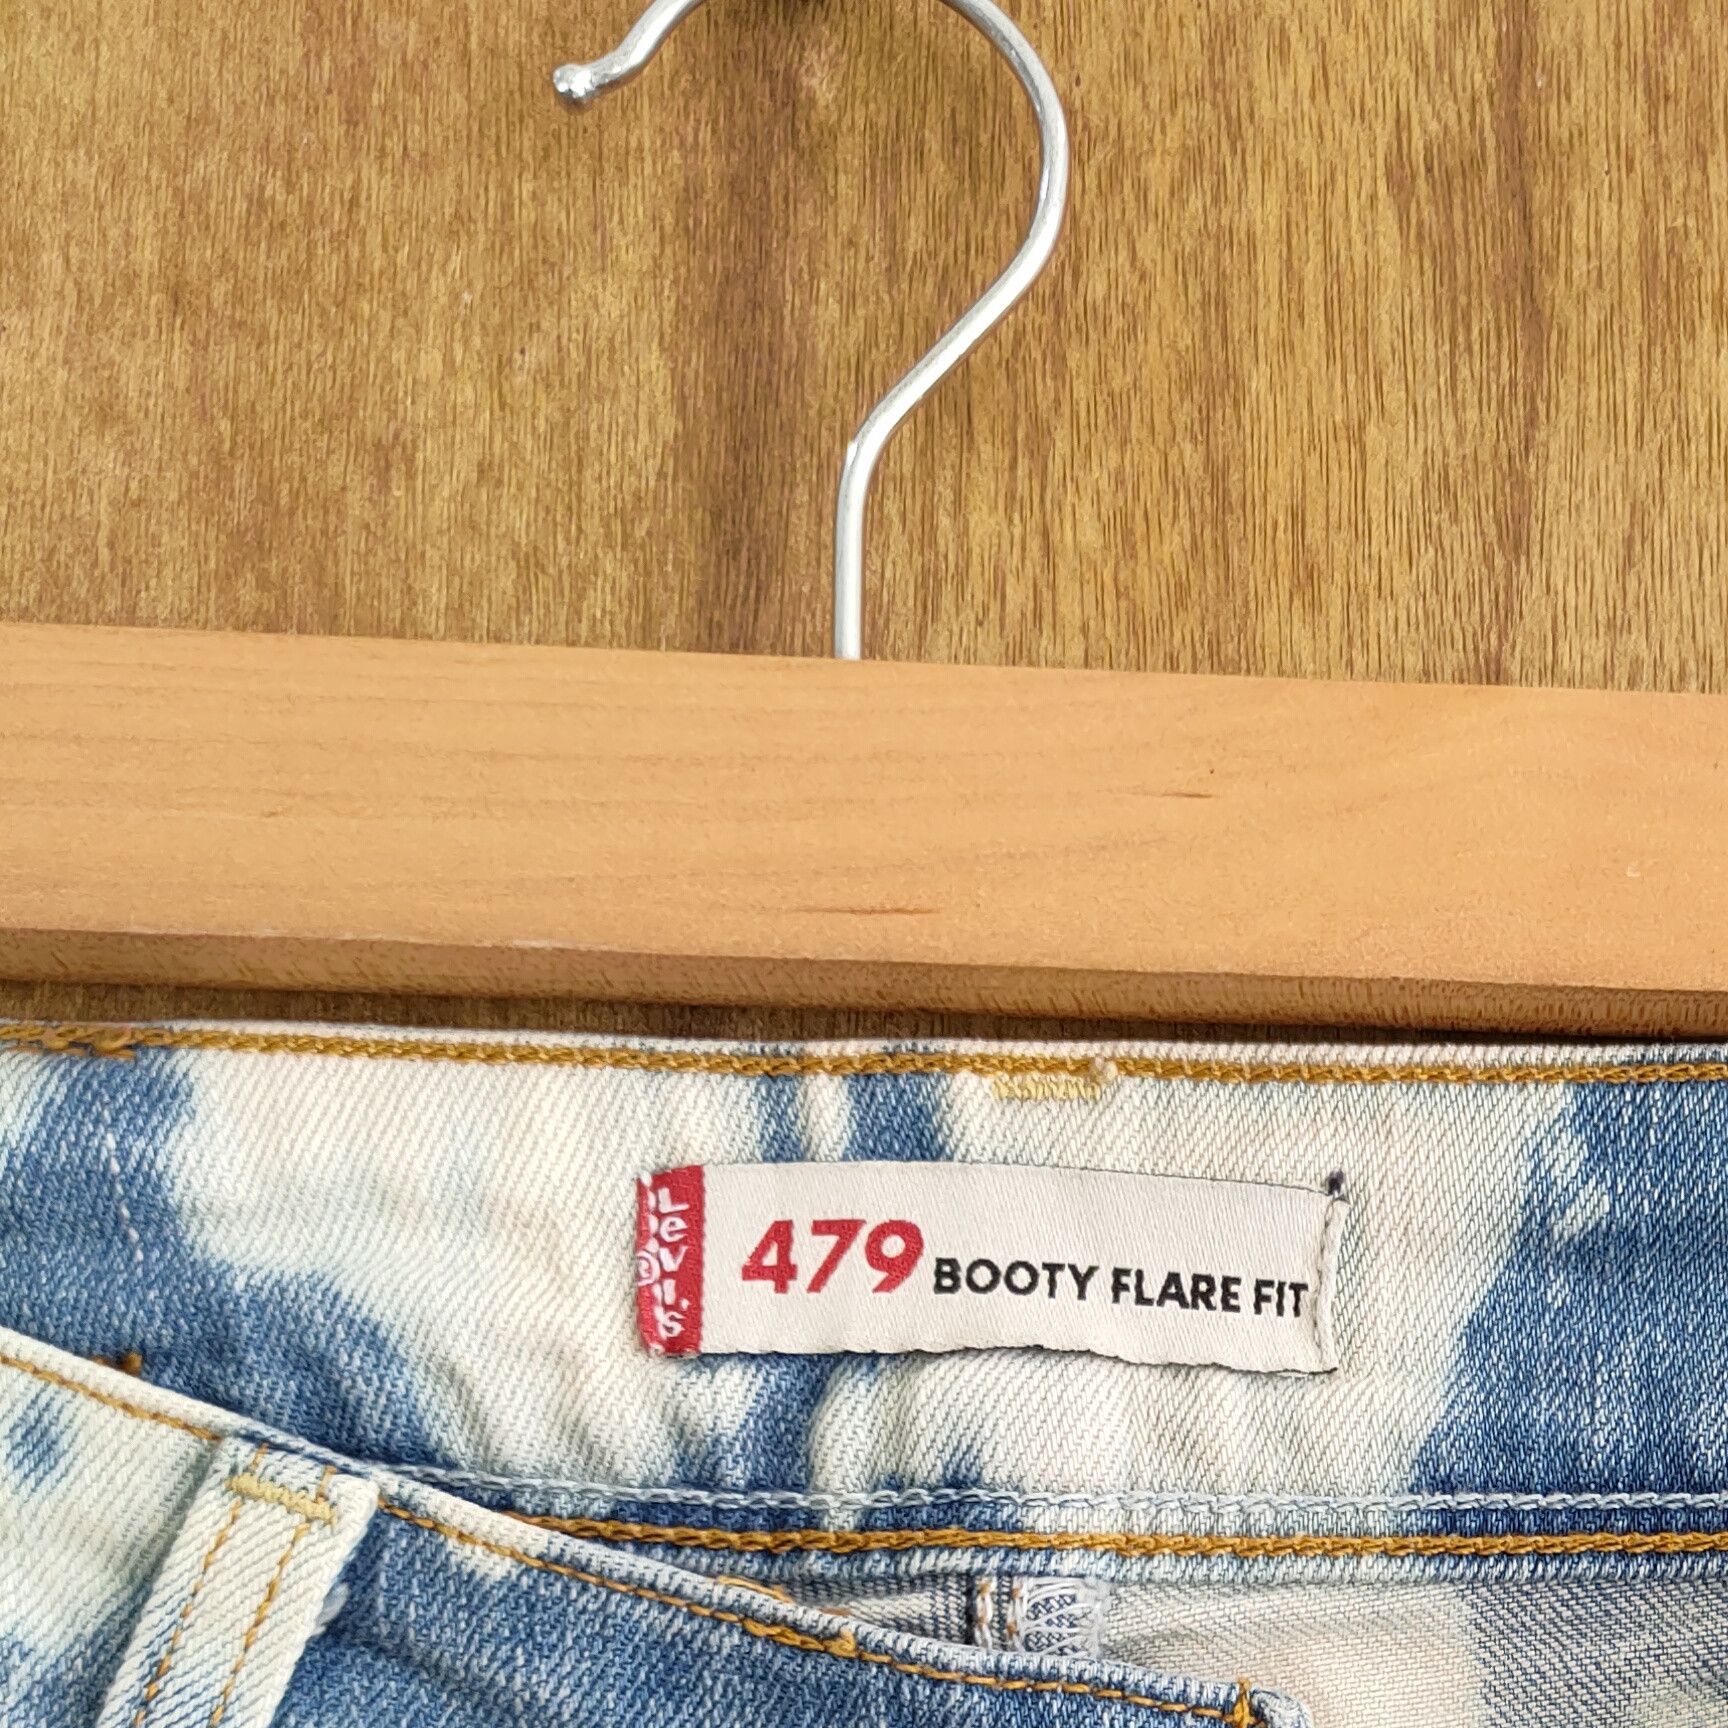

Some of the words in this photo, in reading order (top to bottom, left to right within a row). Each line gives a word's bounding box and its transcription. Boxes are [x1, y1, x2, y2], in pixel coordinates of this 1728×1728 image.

[741, 1218, 925, 1294] 479
[933, 1257, 1099, 1300] BOOTY
[1111, 1267, 1242, 1313] FLARE
[1253, 1278, 1310, 1318] FIT
